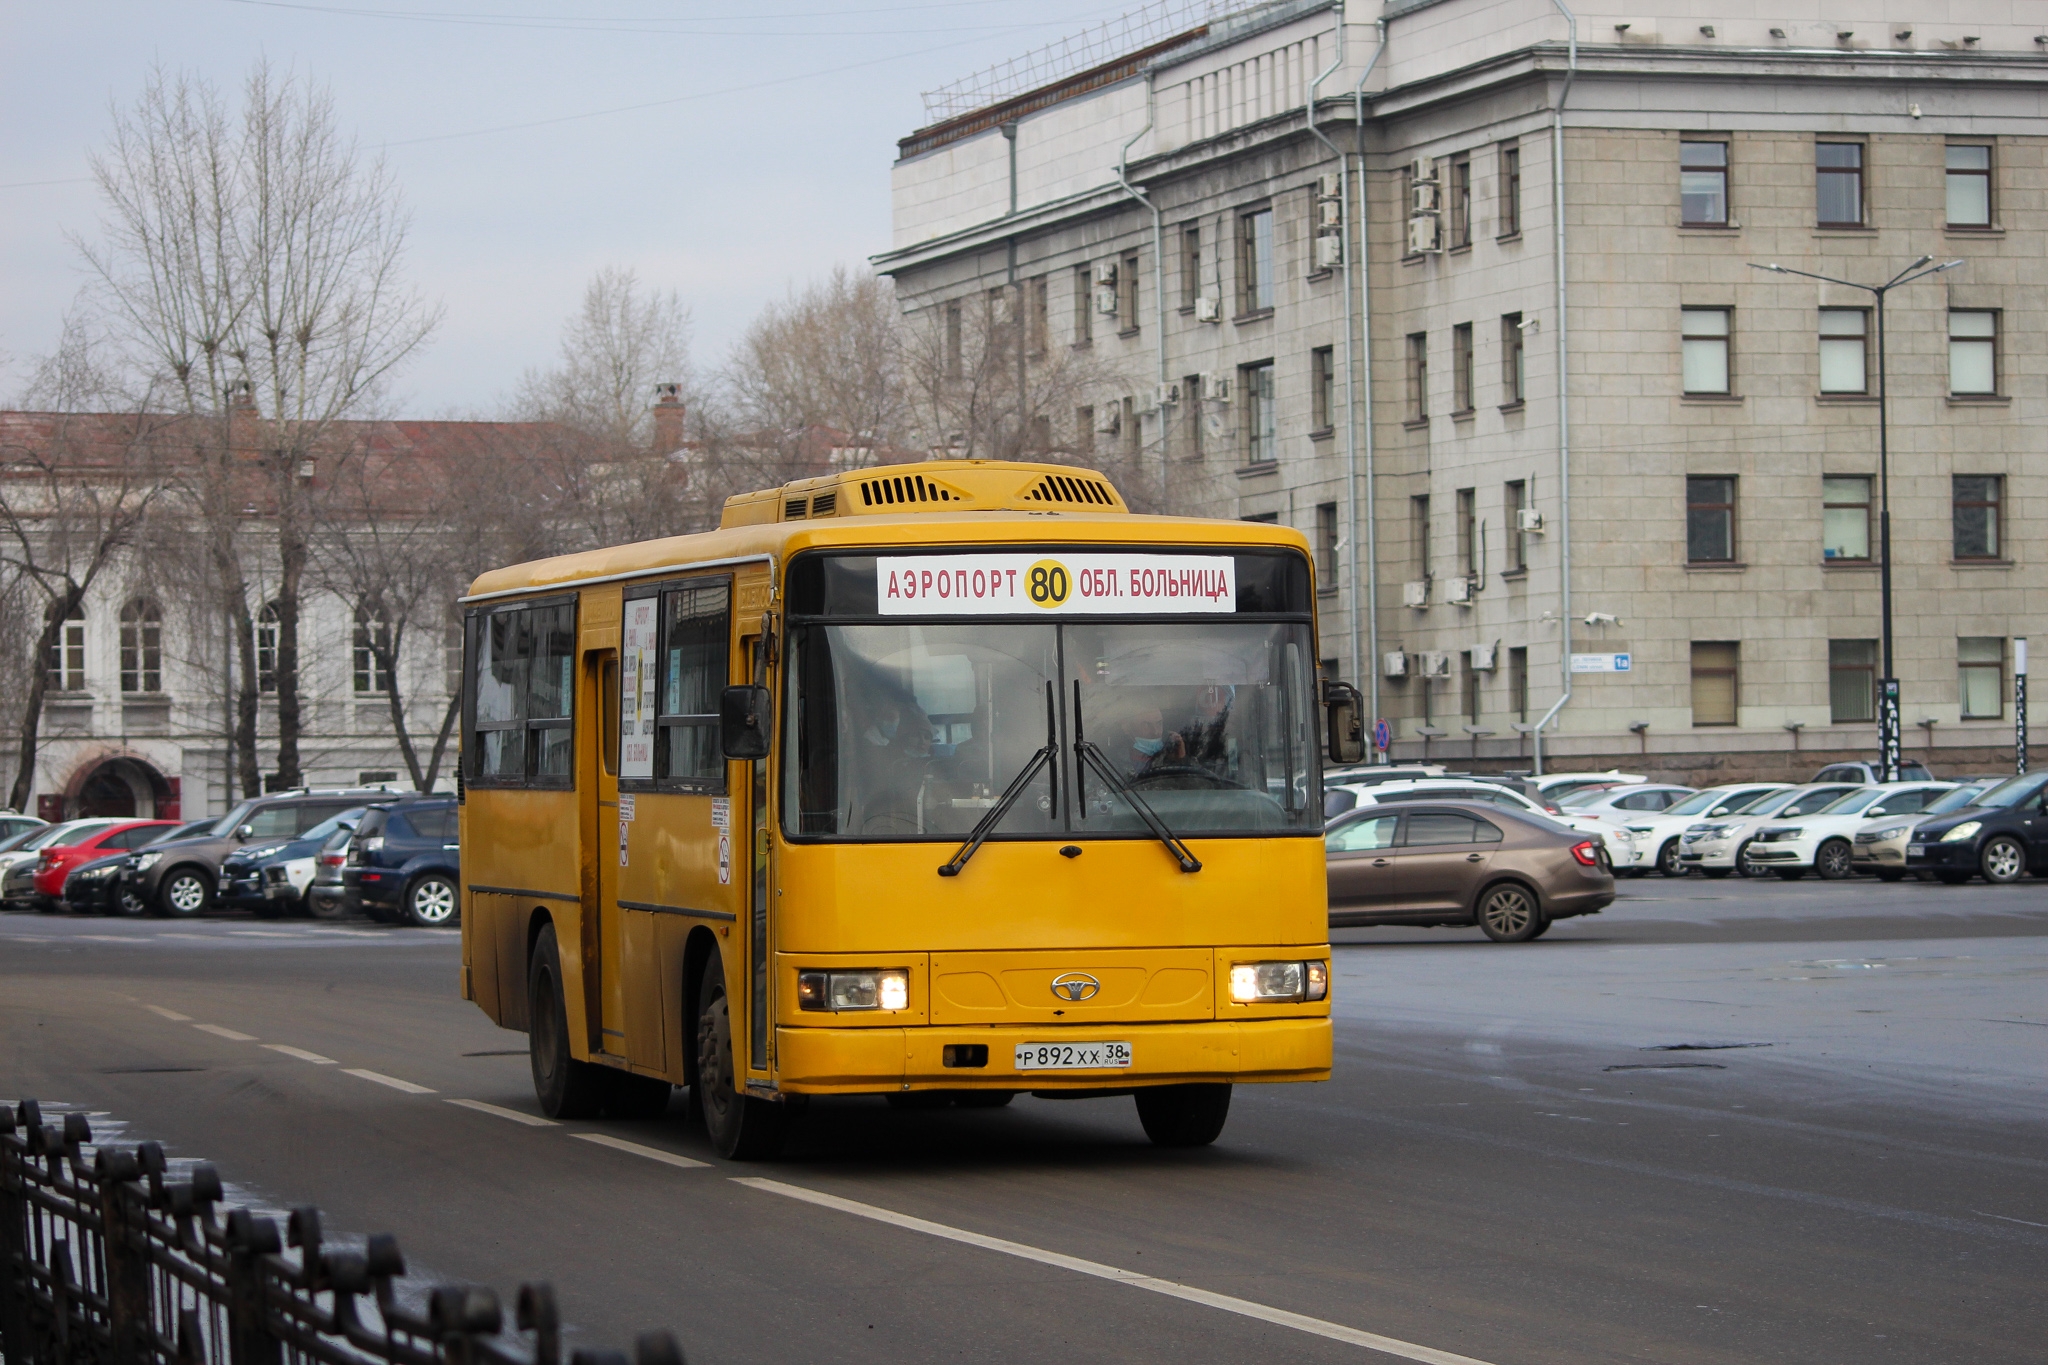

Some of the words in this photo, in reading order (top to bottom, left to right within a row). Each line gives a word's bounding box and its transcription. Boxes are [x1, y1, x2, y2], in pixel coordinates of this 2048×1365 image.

[887, 569, 1017, 599] АЭРОПОРТ
[1030, 566, 1068, 602] 80
[1079, 568, 1124, 597] ОБЛ.
[1130, 568, 1229, 603] БОЛЬНИЦА
[1105, 1044, 1124, 1059] 38
